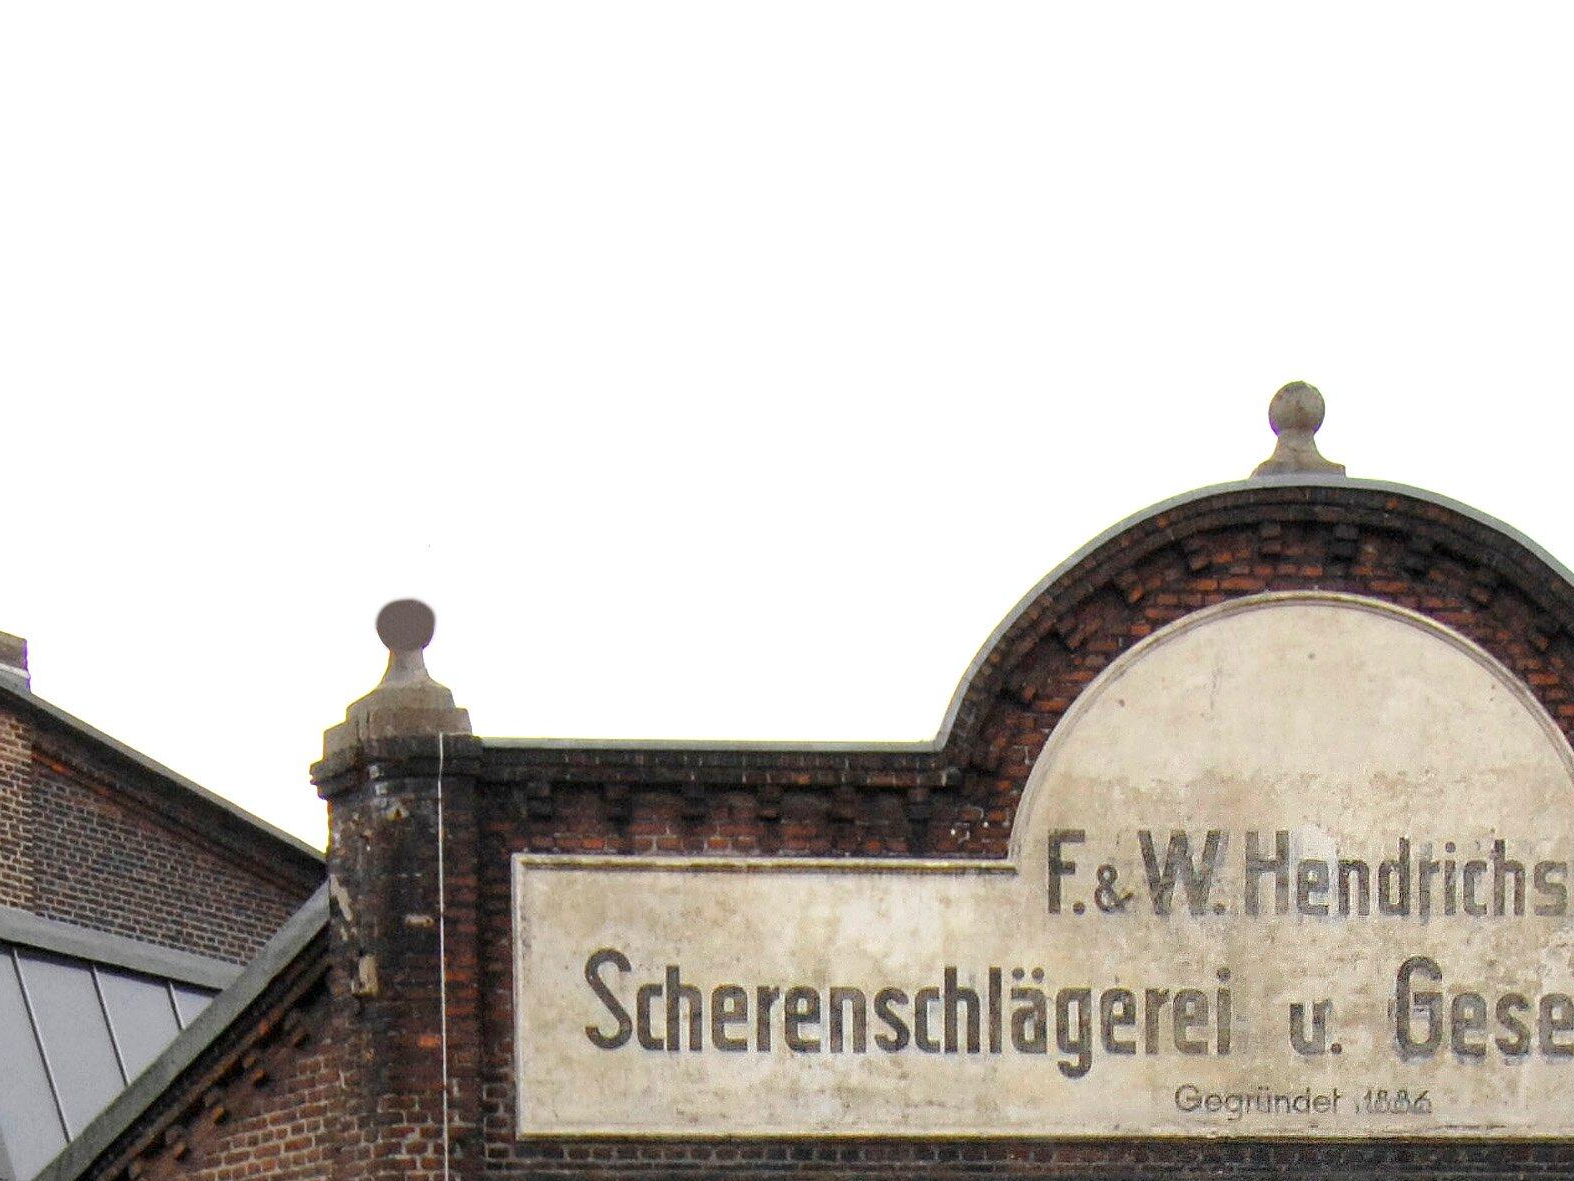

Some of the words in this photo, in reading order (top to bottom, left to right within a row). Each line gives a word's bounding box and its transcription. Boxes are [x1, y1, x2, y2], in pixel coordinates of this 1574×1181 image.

[1244, 828, 1569, 919] Hendrichs
[583, 946, 1232, 1079] Scherenschlägerei
[1289, 1000, 1344, 1056] u.
[1174, 1084, 1342, 1121] Gegründet
